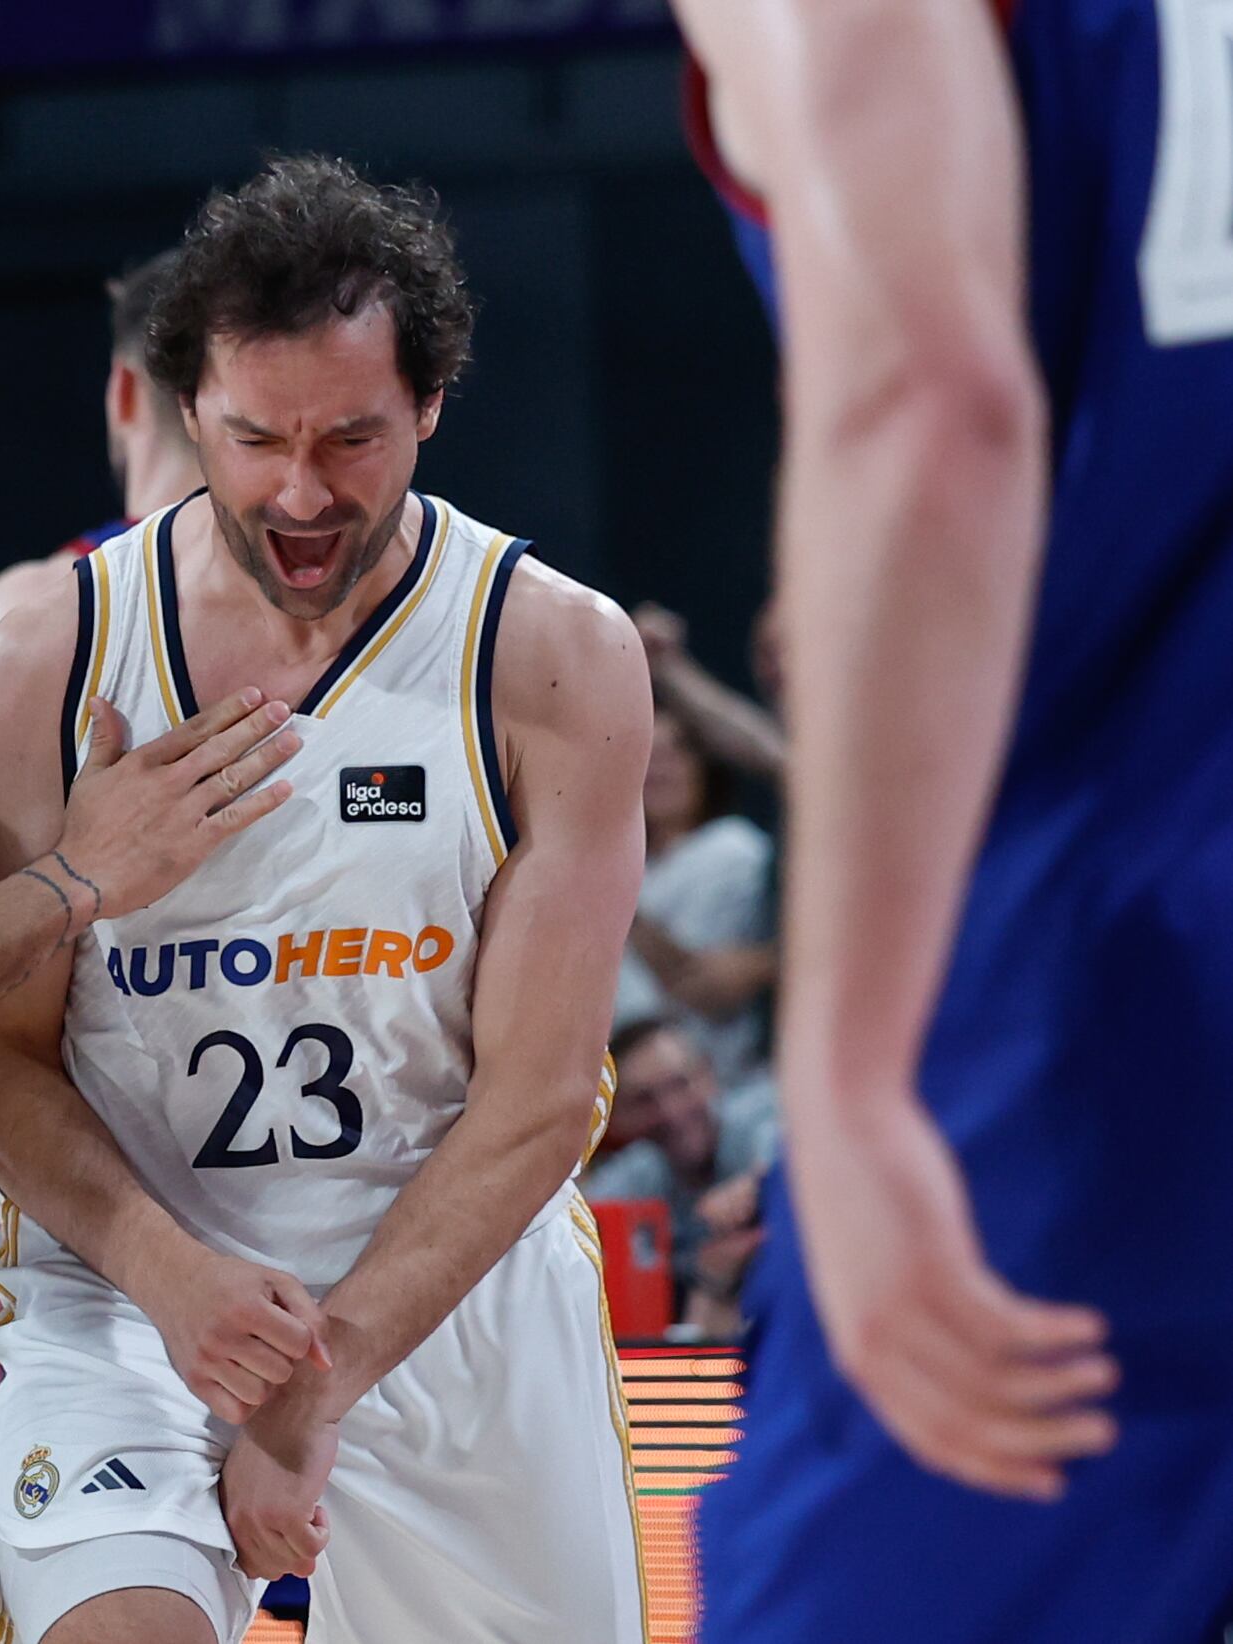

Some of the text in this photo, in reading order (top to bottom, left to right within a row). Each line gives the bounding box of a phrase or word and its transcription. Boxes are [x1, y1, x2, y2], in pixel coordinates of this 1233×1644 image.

[347, 782, 381, 802] liga
[347, 798, 422, 816] endesa
[107, 925, 455, 997] AUTOHERO
[187, 1023, 363, 1169] 23
